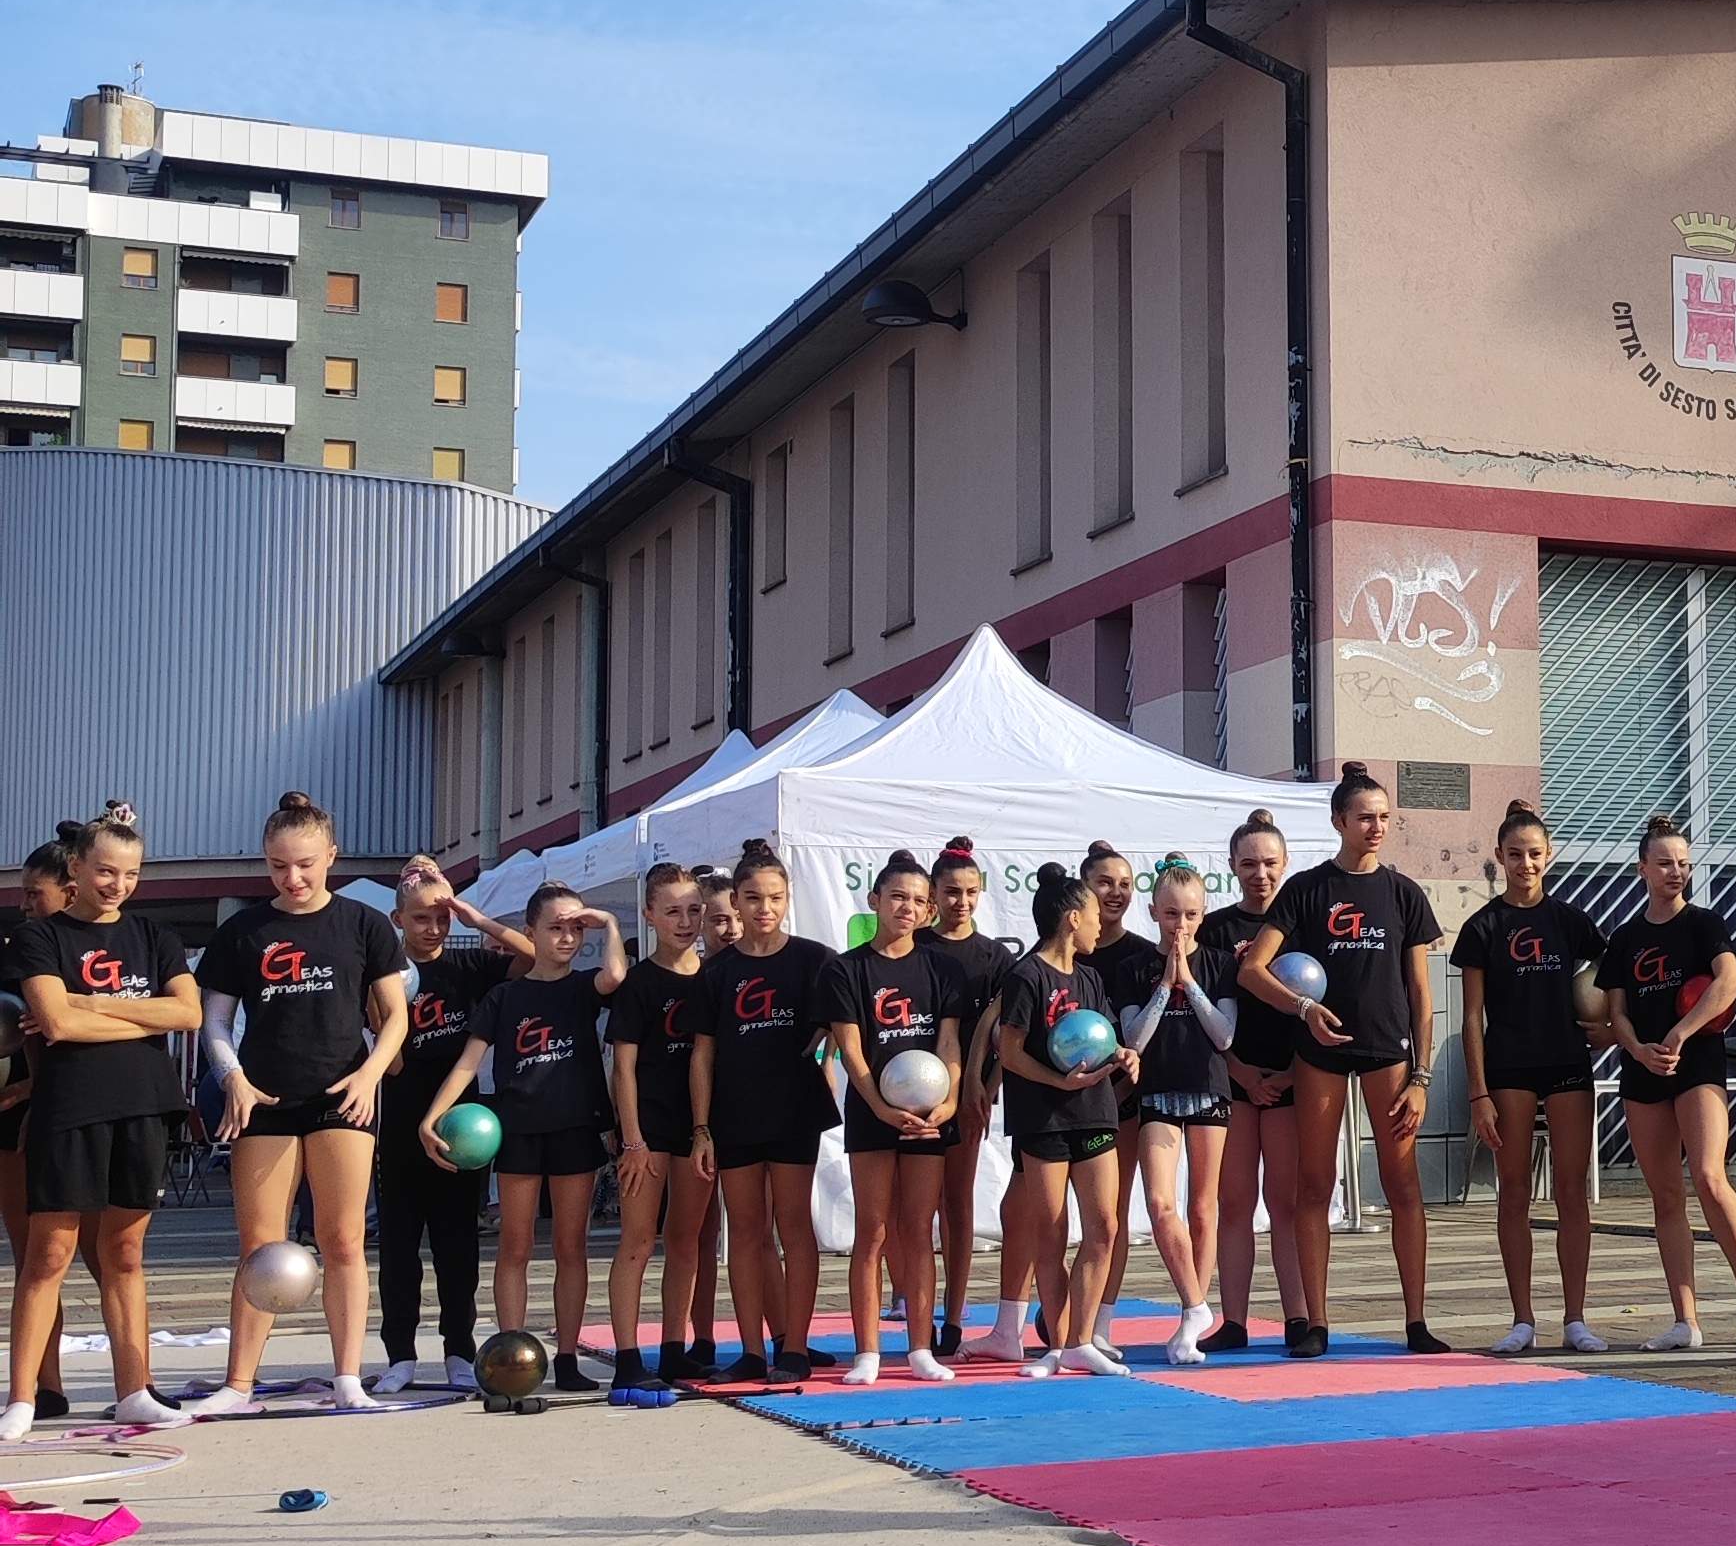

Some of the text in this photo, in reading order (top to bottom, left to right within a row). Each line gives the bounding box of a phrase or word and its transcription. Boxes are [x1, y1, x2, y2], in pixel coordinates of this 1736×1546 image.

[1612, 301, 1647, 361] CITTA'
[1638, 362, 1662, 388] DI
[1659, 381, 1717, 421] SESTO
[1328, 903, 1386, 939] GEAS
[261, 940, 334, 981] GEAS
[1509, 926, 1561, 964] GEAS
[1634, 946, 1682, 982] GEAS
[82, 949, 149, 991] GEAS
[261, 979, 334, 1002] ginnastica
[734, 977, 794, 1020] GEAS
[874, 987, 934, 1027] GEAS
[413, 992, 466, 1030] GEAS
[738, 1018, 794, 1035] ginnastica
[515, 1016, 574, 1053] GEAS
[878, 1024, 936, 1044] ginnastica
